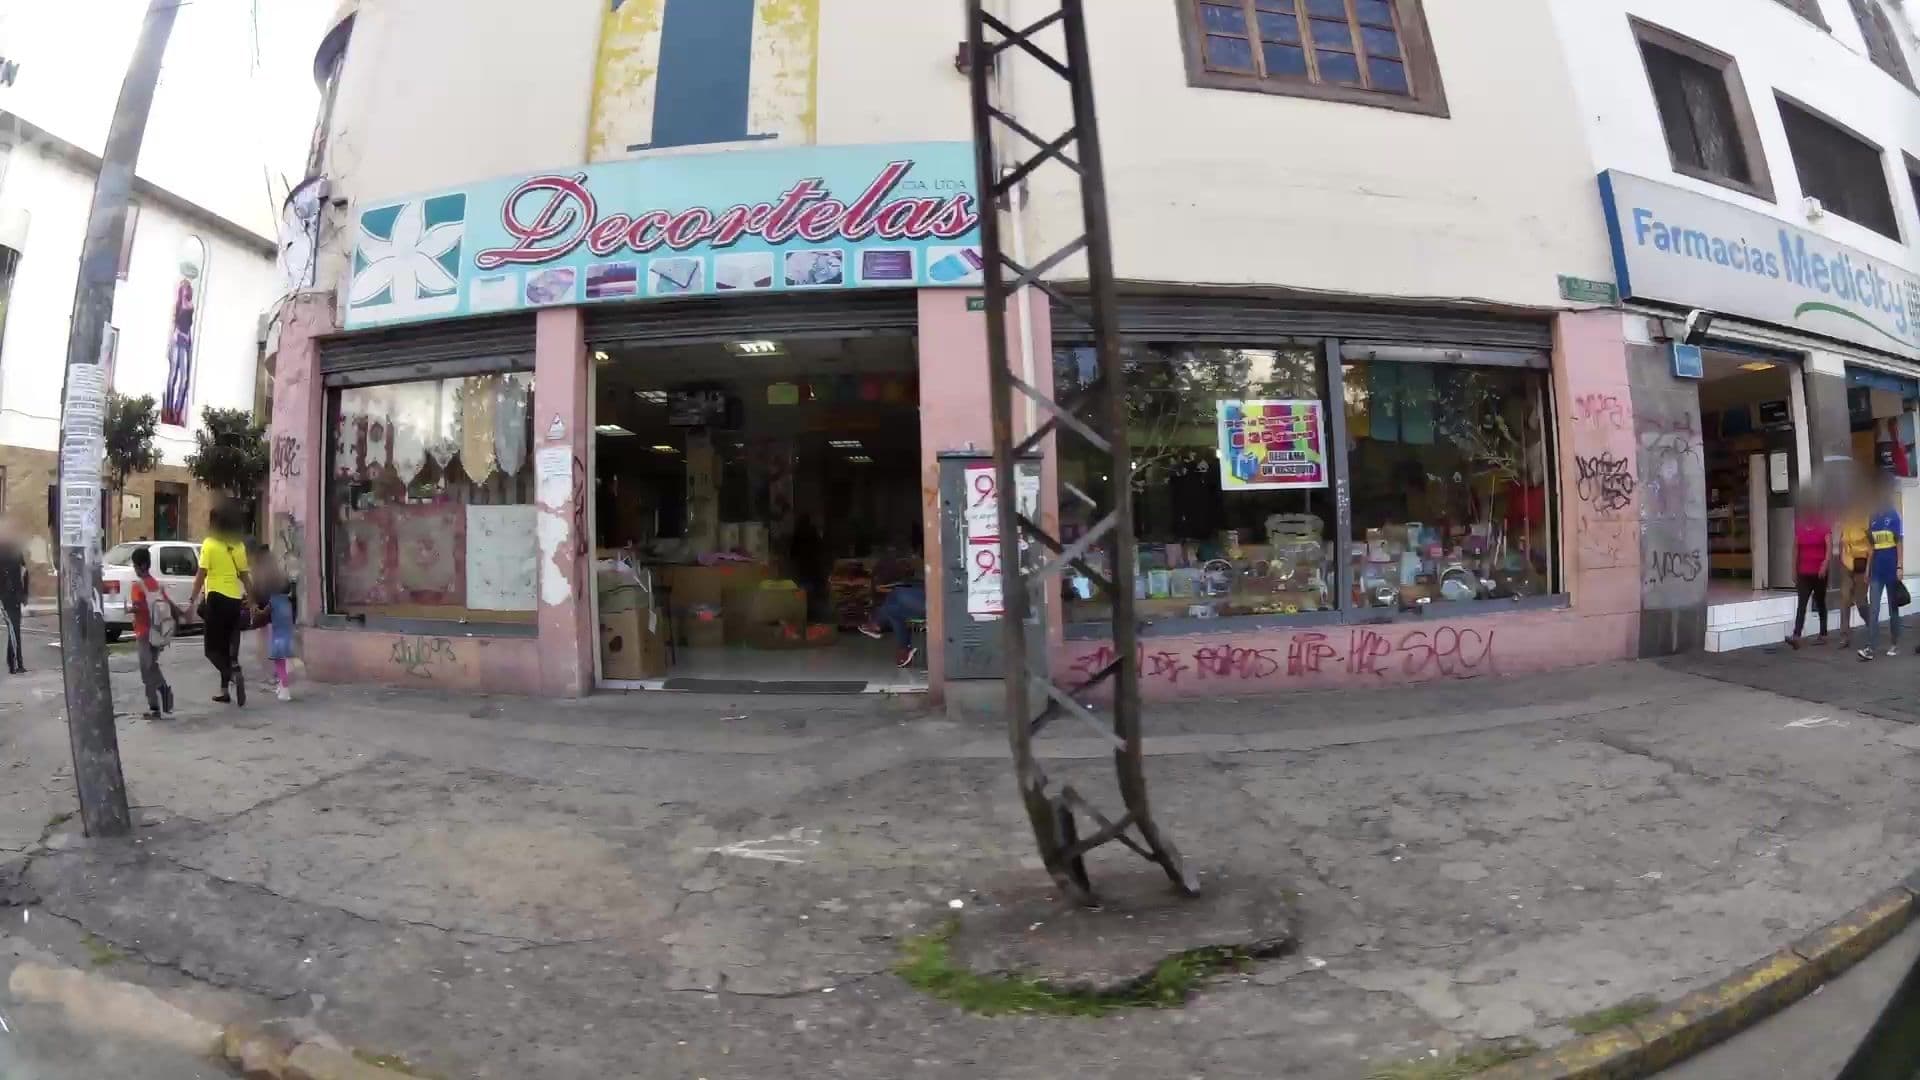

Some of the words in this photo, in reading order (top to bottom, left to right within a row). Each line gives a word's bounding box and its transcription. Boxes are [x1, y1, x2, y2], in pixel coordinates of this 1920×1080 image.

[475, 160, 979, 270] Decortelas
[1633, 207, 1780, 279] Farmacias
[1778, 229, 1908, 335] Medicity
